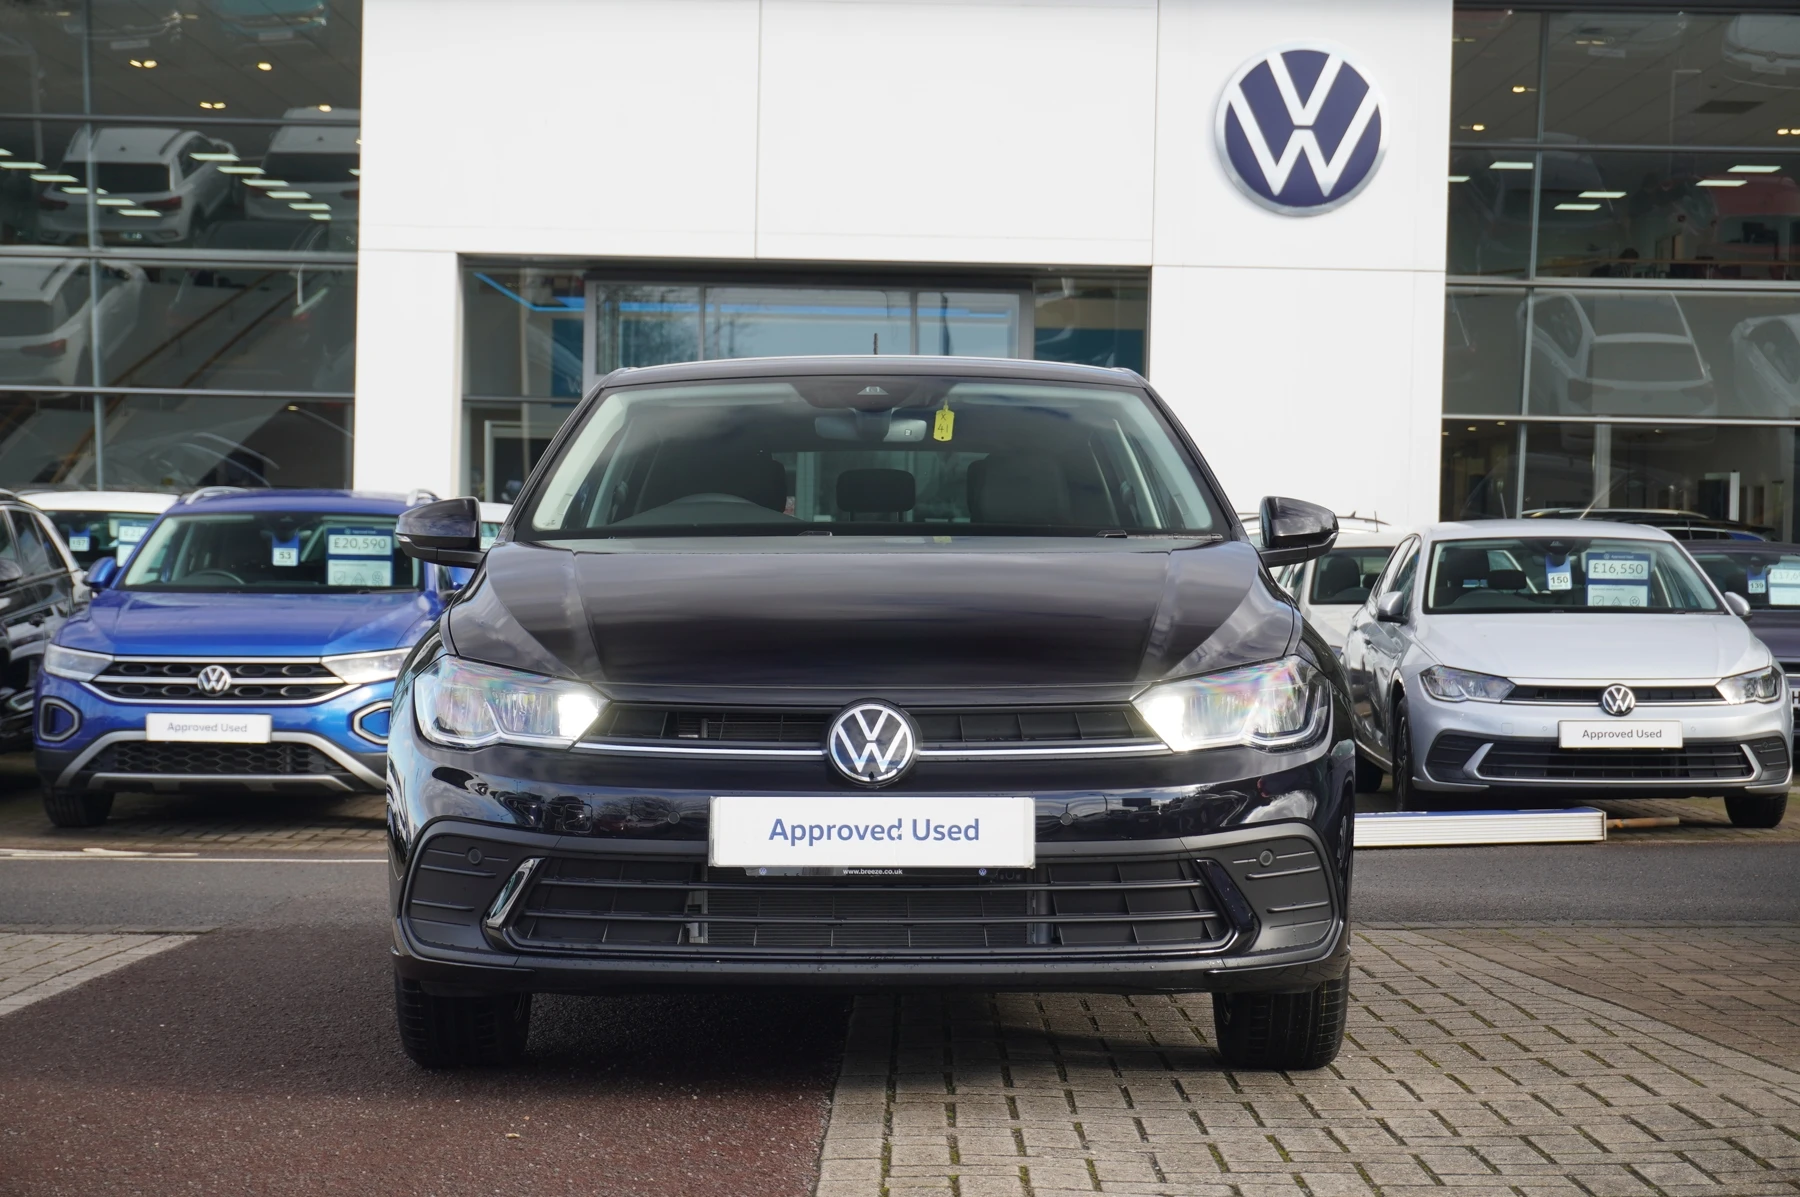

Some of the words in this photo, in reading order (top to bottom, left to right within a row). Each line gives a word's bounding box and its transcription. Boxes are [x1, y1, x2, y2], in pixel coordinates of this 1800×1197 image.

[1221, 45, 1385, 204] VW
[334, 537, 387, 550] £20,590
[280, 551, 292, 560] 53
[1593, 562, 1644, 575] £16,550
[1551, 576, 1569, 585] 150
[167, 722, 218, 733] Approved
[221, 723, 247, 732] Used
[1582, 729, 1633, 740] Approved
[1636, 729, 1662, 738] Used
[768, 818, 902, 847] Approved
[912, 818, 980, 841] Used
[842, 868, 903, 876] www.breeze.co.uk
